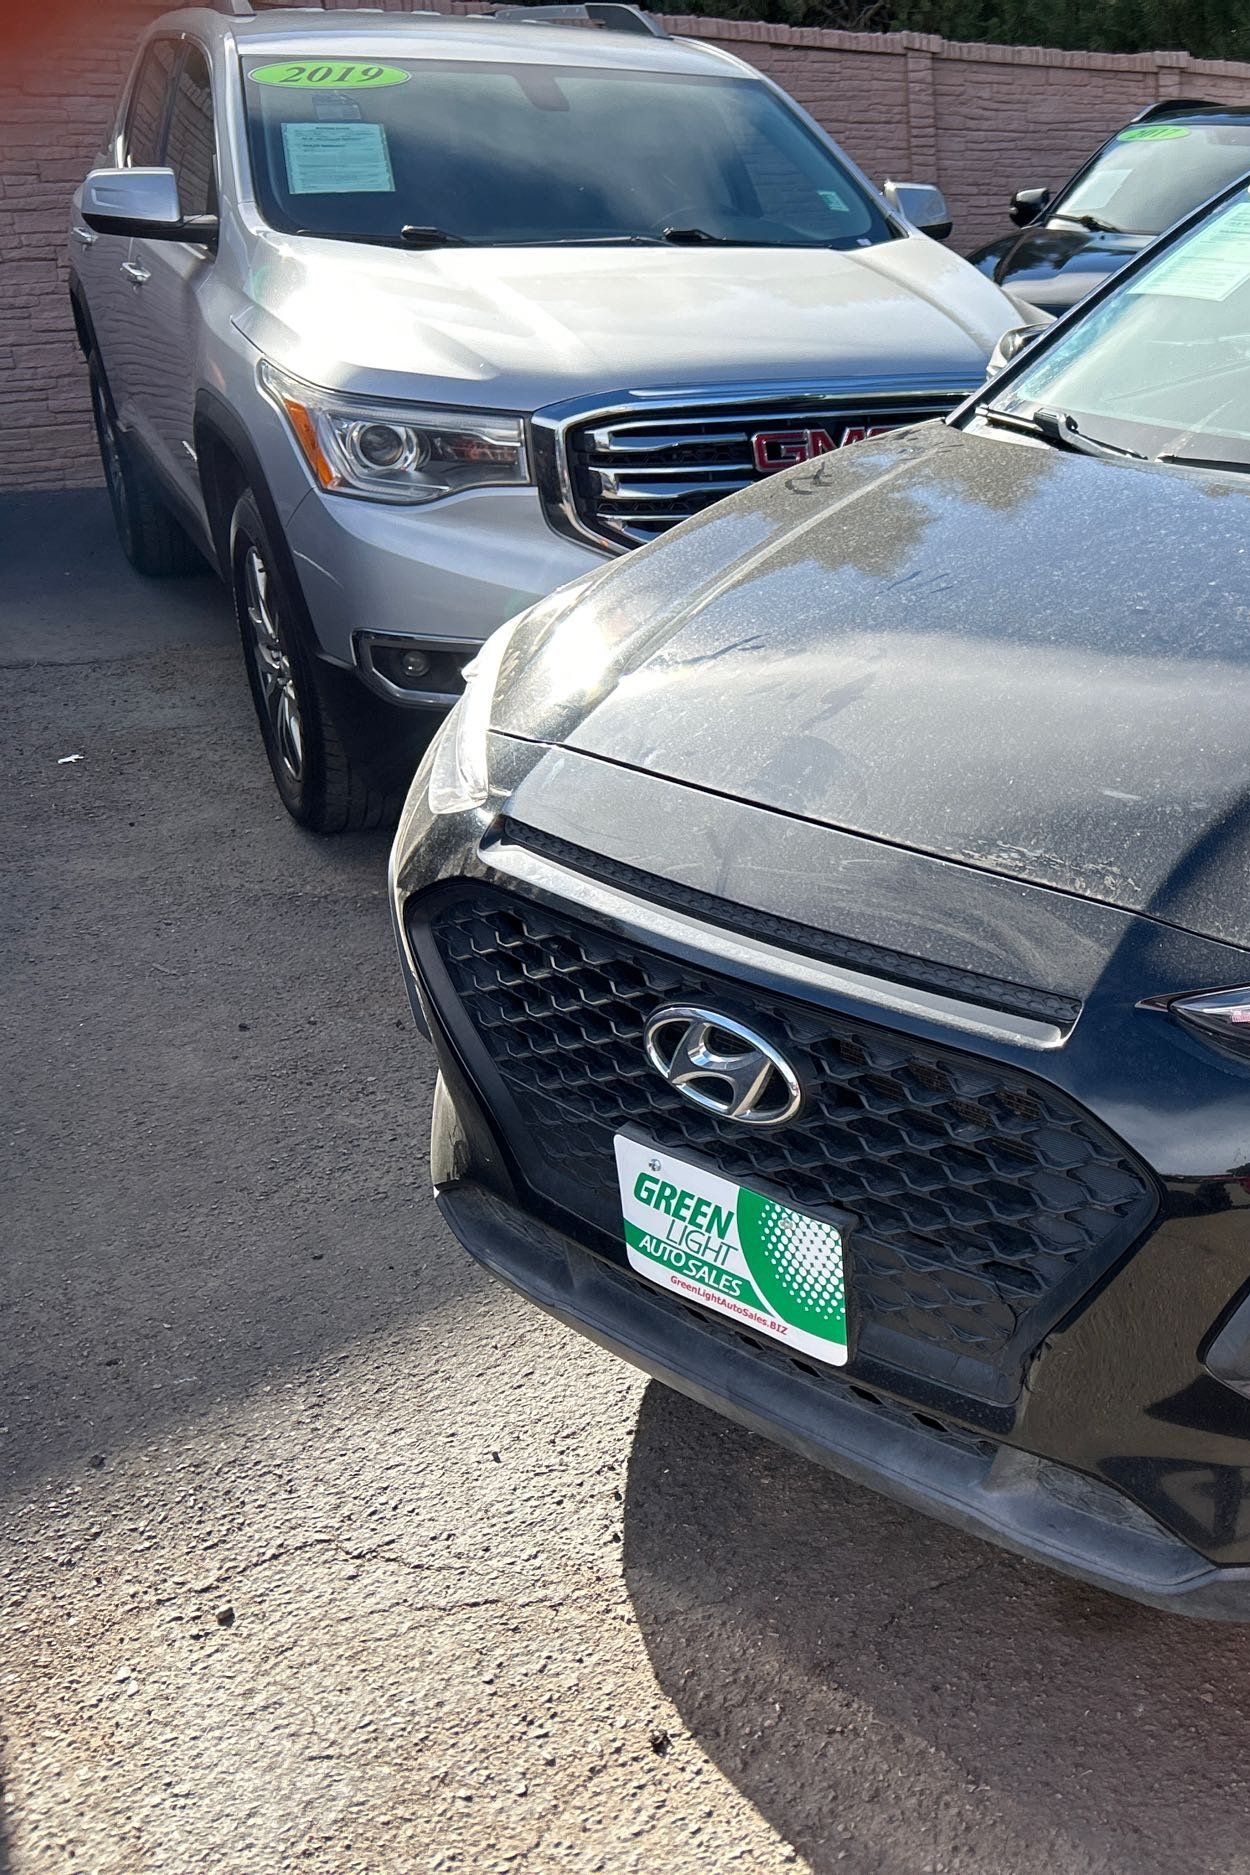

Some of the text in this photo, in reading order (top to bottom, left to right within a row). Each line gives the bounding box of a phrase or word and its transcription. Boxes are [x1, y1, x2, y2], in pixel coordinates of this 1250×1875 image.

[279, 66, 385, 83] 2019
[752, 427, 904, 473] GM
[633, 1172, 735, 1241] GREEN
[665, 1219, 739, 1267] LIGHT
[669, 1274, 789, 1336] GreenLightAutoSales.BIZ
